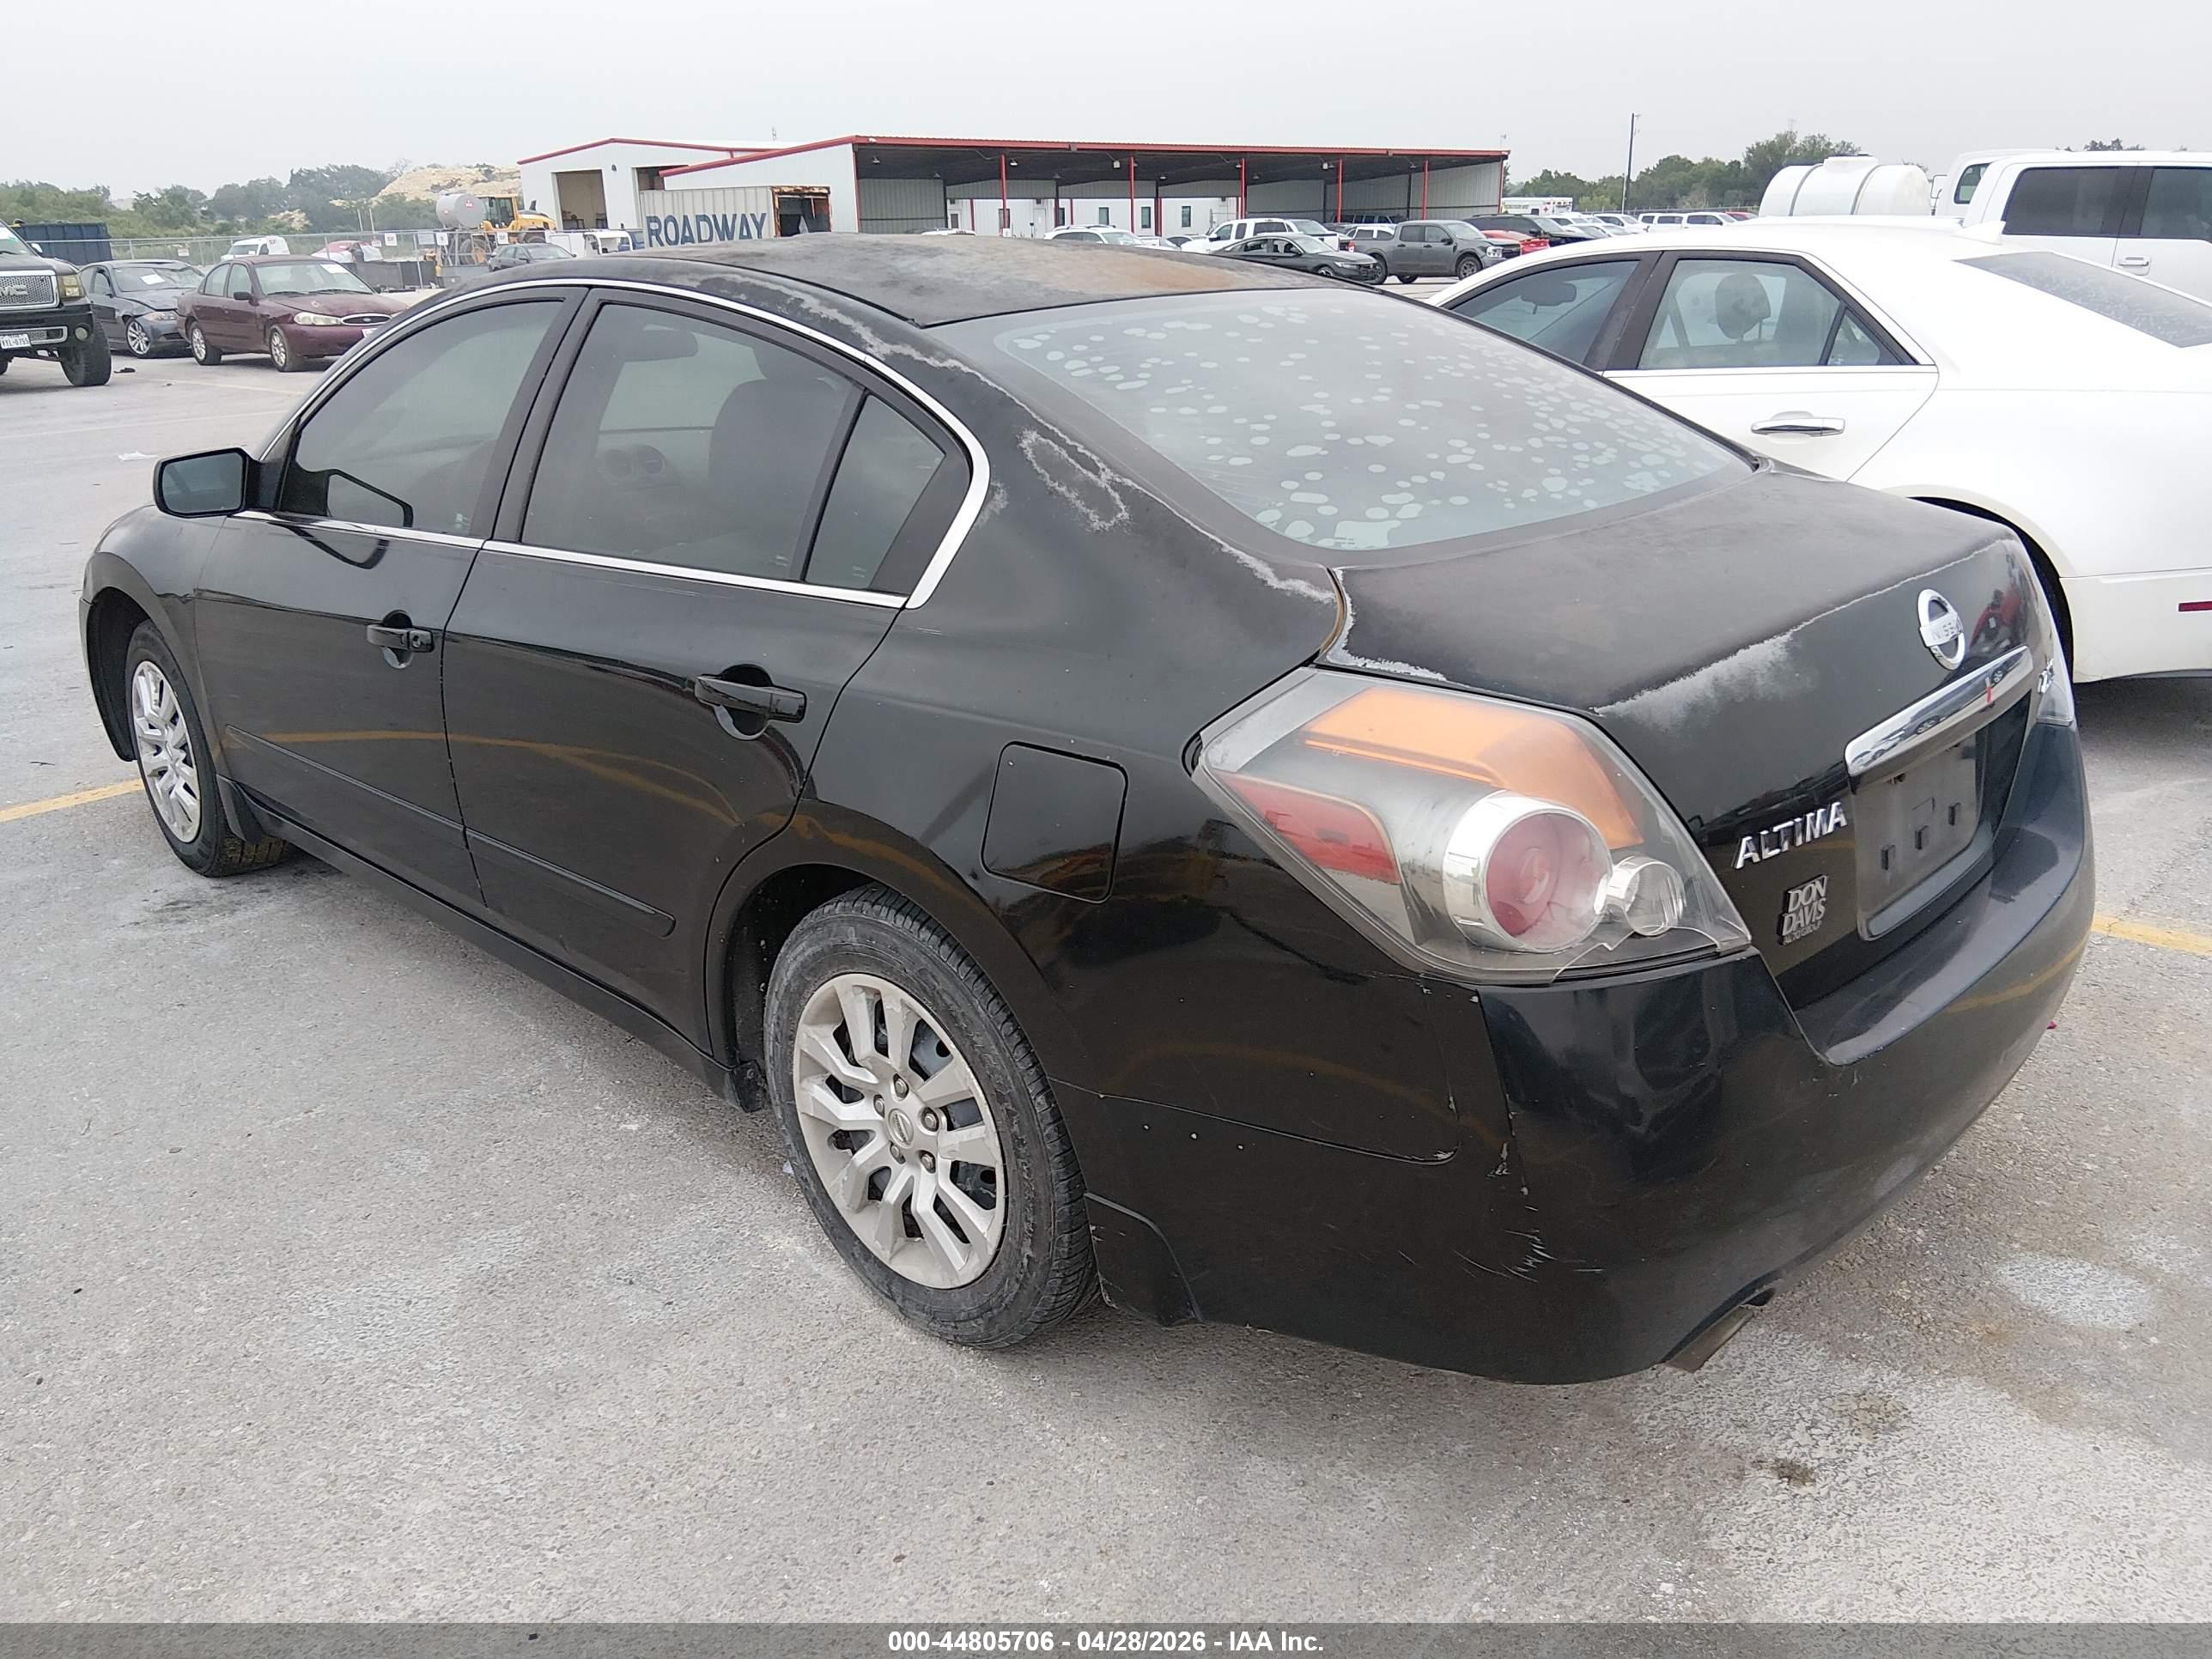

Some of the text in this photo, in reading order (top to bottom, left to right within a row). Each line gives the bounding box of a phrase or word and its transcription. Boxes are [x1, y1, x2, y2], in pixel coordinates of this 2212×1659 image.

[646, 213, 767, 247] ROADWAY
[1734, 801, 1848, 870] ALTIMA
[1788, 875, 1826, 913] DON
[1782, 897, 1826, 936] DAVIS
